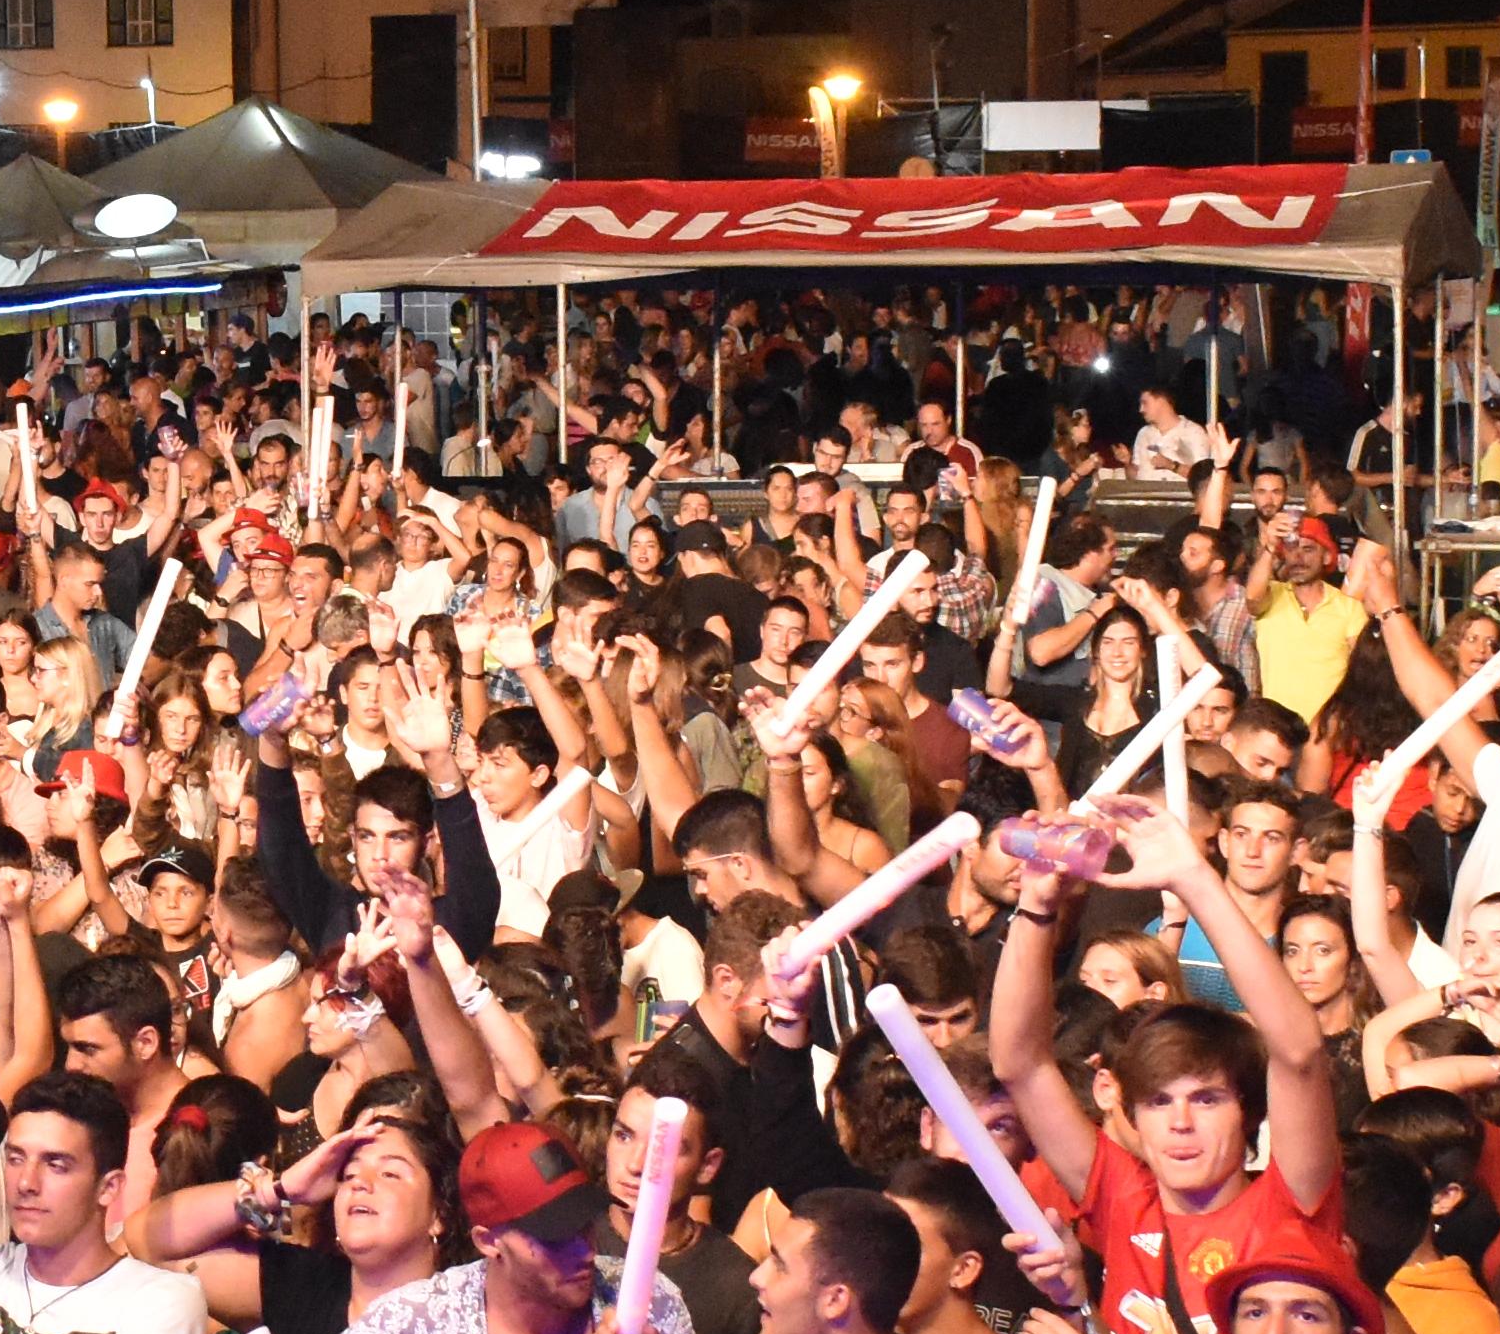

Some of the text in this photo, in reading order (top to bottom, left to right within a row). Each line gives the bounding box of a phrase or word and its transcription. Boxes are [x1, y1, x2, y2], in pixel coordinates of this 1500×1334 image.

[1293, 122, 1356, 138] NISSA
[522, 191, 1316, 240] NISSAN
[649, 1120, 669, 1184] NISSAN
